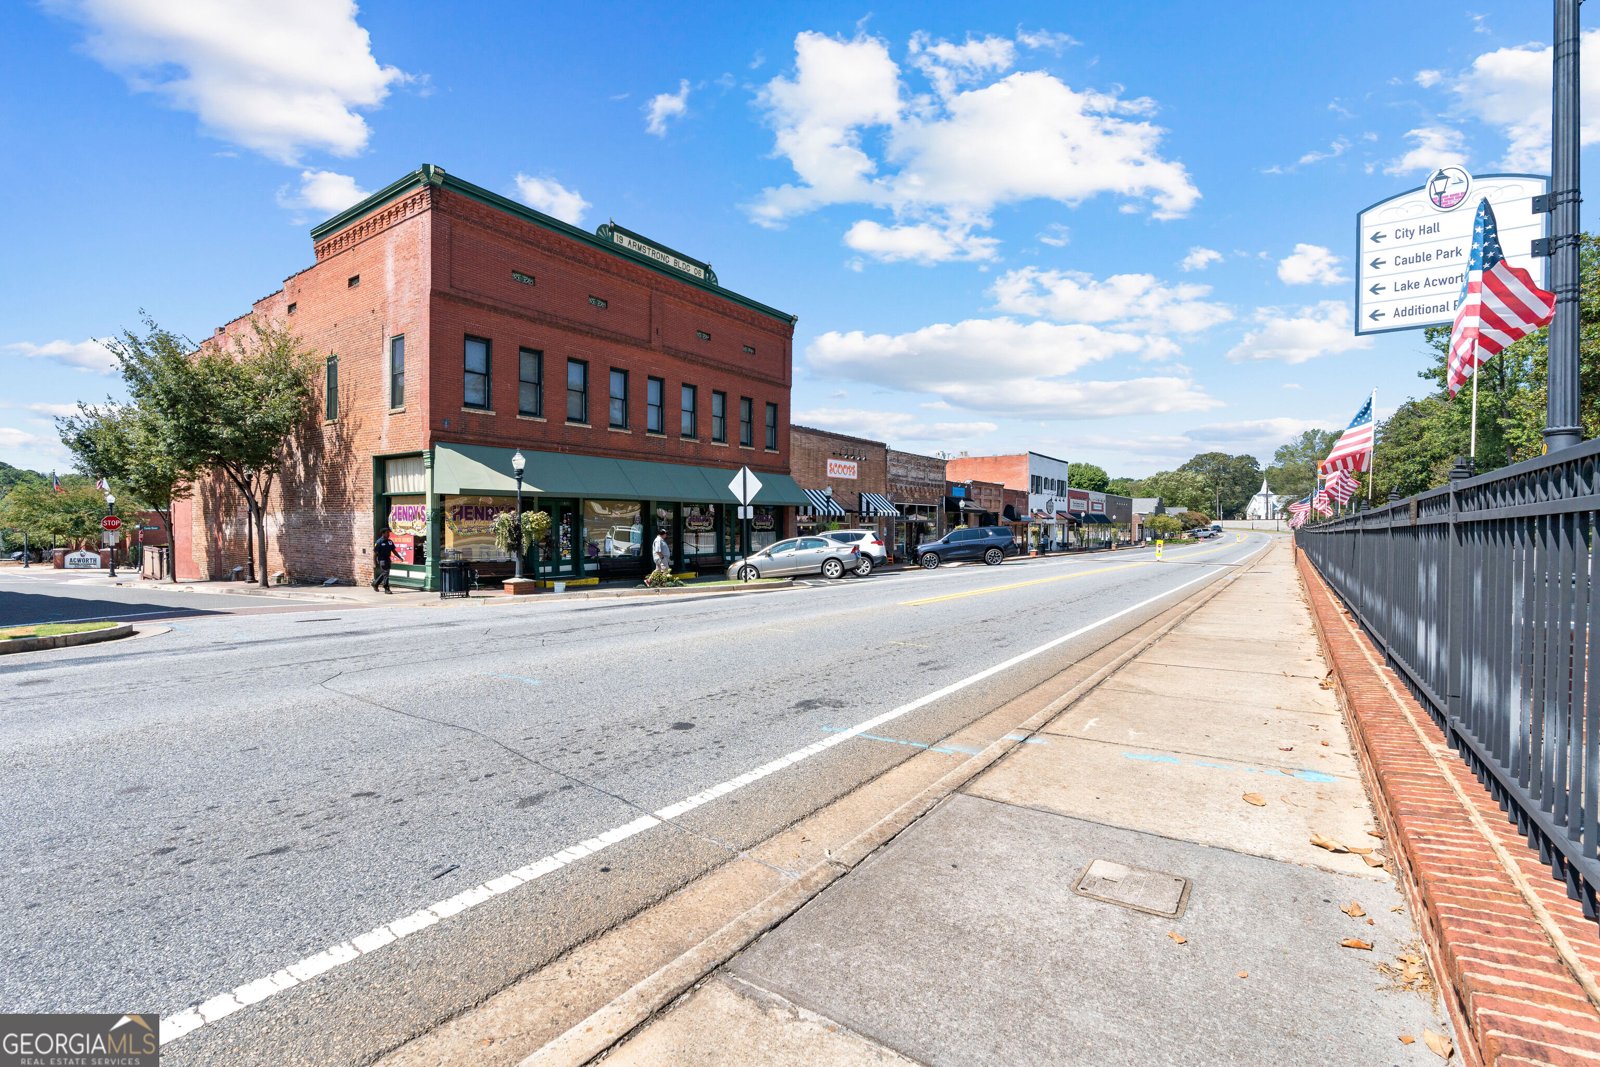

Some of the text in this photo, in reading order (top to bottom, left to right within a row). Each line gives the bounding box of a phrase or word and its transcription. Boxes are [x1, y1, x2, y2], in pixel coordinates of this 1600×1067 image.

[1395, 222, 1440, 240] City Hall
[616, 234, 624, 244] 19
[627, 239, 670, 263] ARMSTRONG
[673, 258, 691, 272] BLDG
[1394, 246, 1463, 266] Cauble Park
[1394, 272, 1464, 292] Lake Acwort
[1393, 301, 1450, 318] Additional
[391, 504, 426, 522] HENRY'S
[451, 504, 515, 521] HENR
